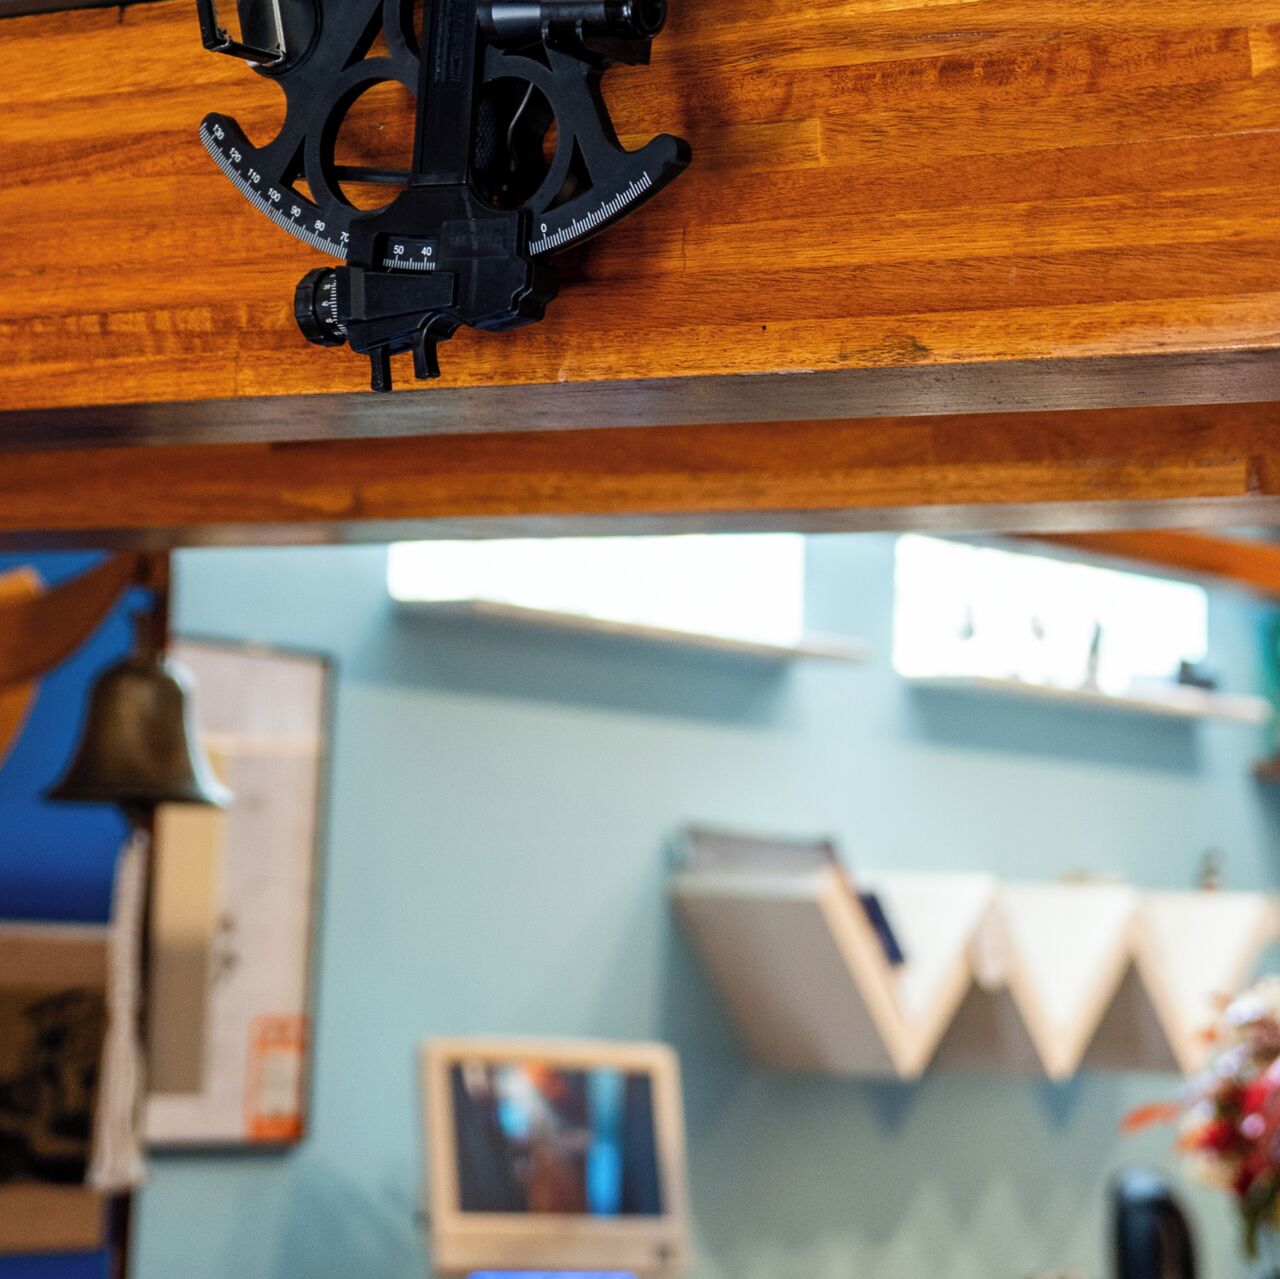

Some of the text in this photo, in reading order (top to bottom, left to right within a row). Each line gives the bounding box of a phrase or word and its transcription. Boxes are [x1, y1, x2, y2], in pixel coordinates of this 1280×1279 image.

[212, 124, 224, 140] 130
[229, 147, 242, 163] 120
[247, 169, 260, 184] 110
[268, 188, 281, 202] 100
[290, 205, 301, 217] 90
[314, 220, 326, 231] 80
[541, 223, 547, 233] 0
[393, 245, 432, 256] 50 40
